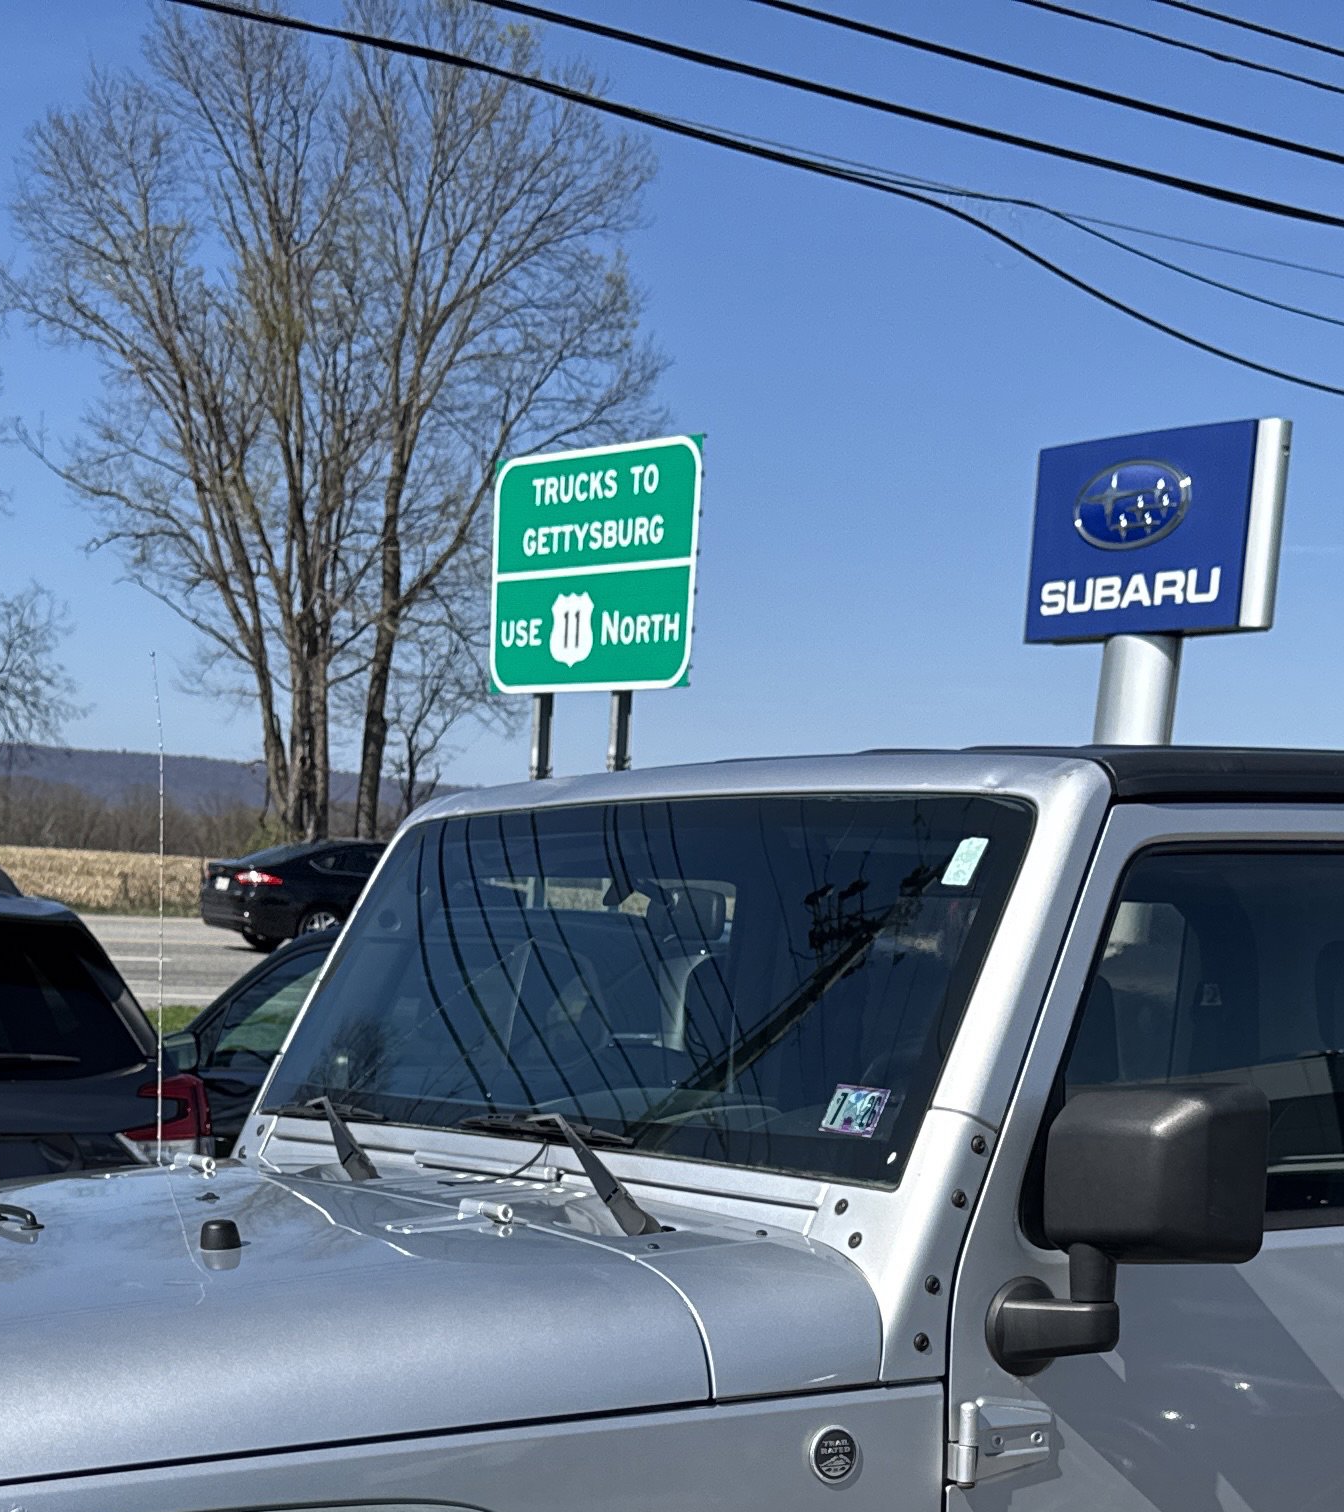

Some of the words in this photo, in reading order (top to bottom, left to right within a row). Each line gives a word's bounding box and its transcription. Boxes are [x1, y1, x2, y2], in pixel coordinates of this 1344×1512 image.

[532, 469, 618, 507] TRUCKS
[630, 463, 660, 495] TO
[522, 514, 665, 557] GETTYSBURG
[1039, 565, 1222, 617] SUBARU
[500, 617, 544, 648] USE
[563, 609, 581, 649] 11
[600, 609, 681, 646] NORTH
[829, 1092, 849, 1126] 7
[820, 1446, 851, 1455] RATED
[822, 1439, 849, 1447] TRAIL
